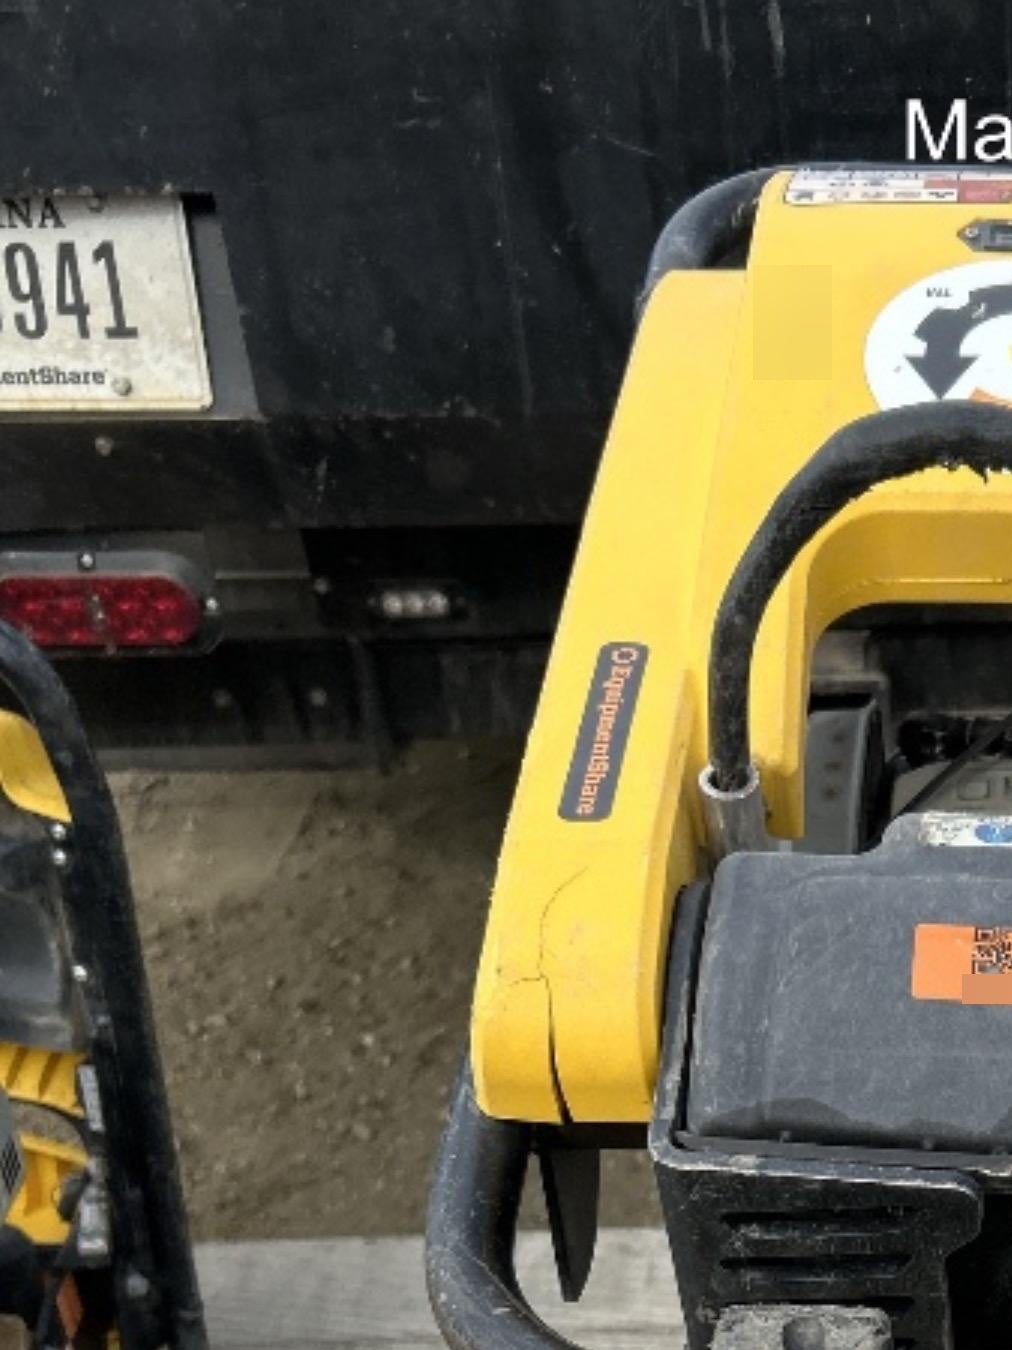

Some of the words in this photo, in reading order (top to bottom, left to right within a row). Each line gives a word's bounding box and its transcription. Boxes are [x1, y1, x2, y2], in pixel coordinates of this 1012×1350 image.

[0, 196, 66, 229] NA
[0, 240, 138, 339] 941
[0, 366, 105, 386] entShare
[575, 665, 634, 816] EquipmentShare
